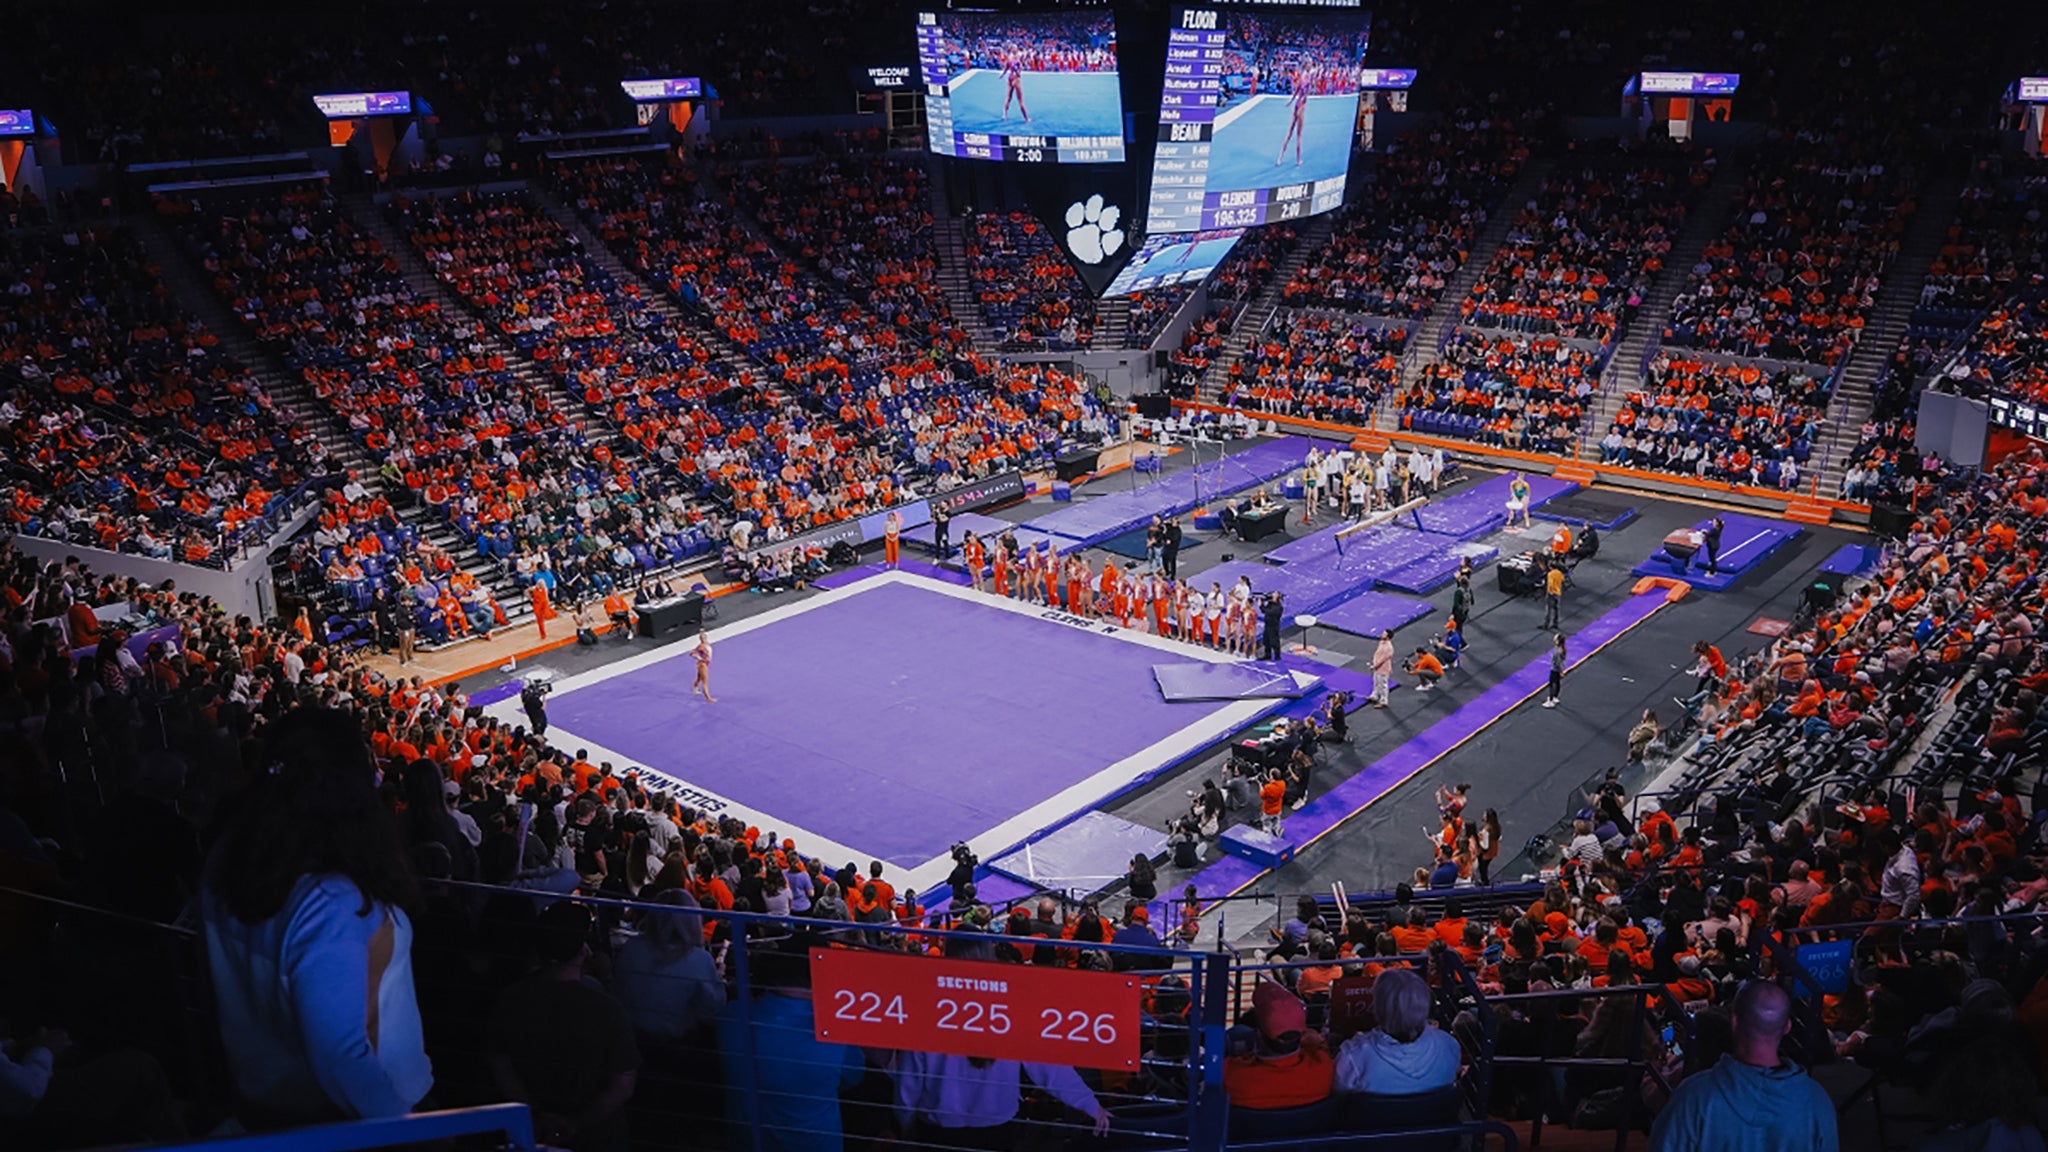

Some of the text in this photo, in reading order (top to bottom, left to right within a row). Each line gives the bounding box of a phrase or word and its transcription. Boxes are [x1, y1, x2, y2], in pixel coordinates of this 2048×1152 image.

[1182, 10, 1217, 29] FLOOR
[868, 67, 910, 77] WELCOME
[1162, 95, 1182, 104] Clark
[1170, 124, 1201, 141] BEAM
[1017, 150, 1043, 162] 2:00
[1219, 190, 1257, 207] CLEMSON
[1214, 208, 1257, 227] 196.325
[1281, 202, 1300, 219] 2:00
[1041, 611, 1119, 634] CLEMSN
[621, 766, 727, 812] GYMNSTICS
[937, 976, 1008, 993] SECTIONS
[834, 990, 1117, 1044] 224 225 226
